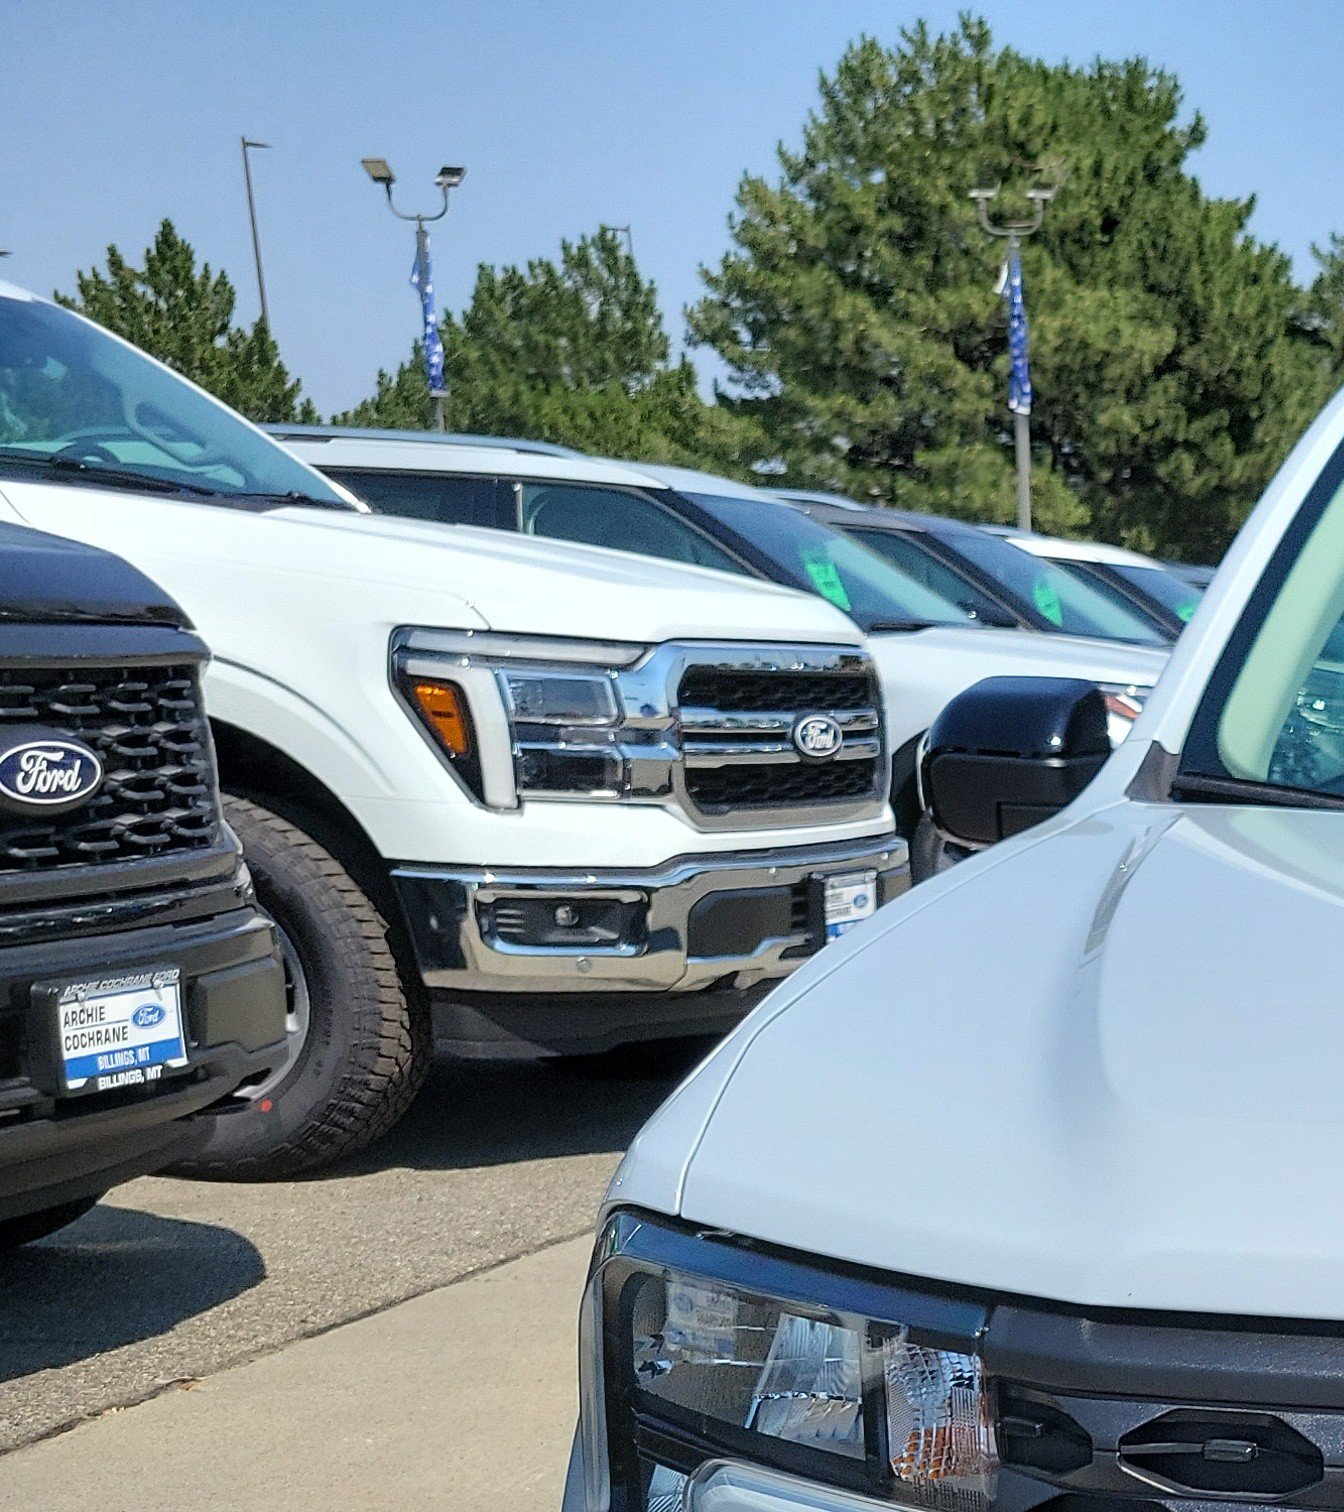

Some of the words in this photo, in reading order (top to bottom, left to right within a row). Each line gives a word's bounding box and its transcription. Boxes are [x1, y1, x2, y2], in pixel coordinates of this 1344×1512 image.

[16, 750, 82, 794] Ford
[64, 1005, 106, 1028] ARCHIE
[138, 1006, 160, 1025] Ford
[64, 1025, 129, 1052] COCHRANE
[97, 1048, 138, 1071] BILLINGS,
[138, 1046, 151, 1062] MT
[98, 1070, 145, 1090] BILLINGS,
[146, 1065, 163, 1080] MT
